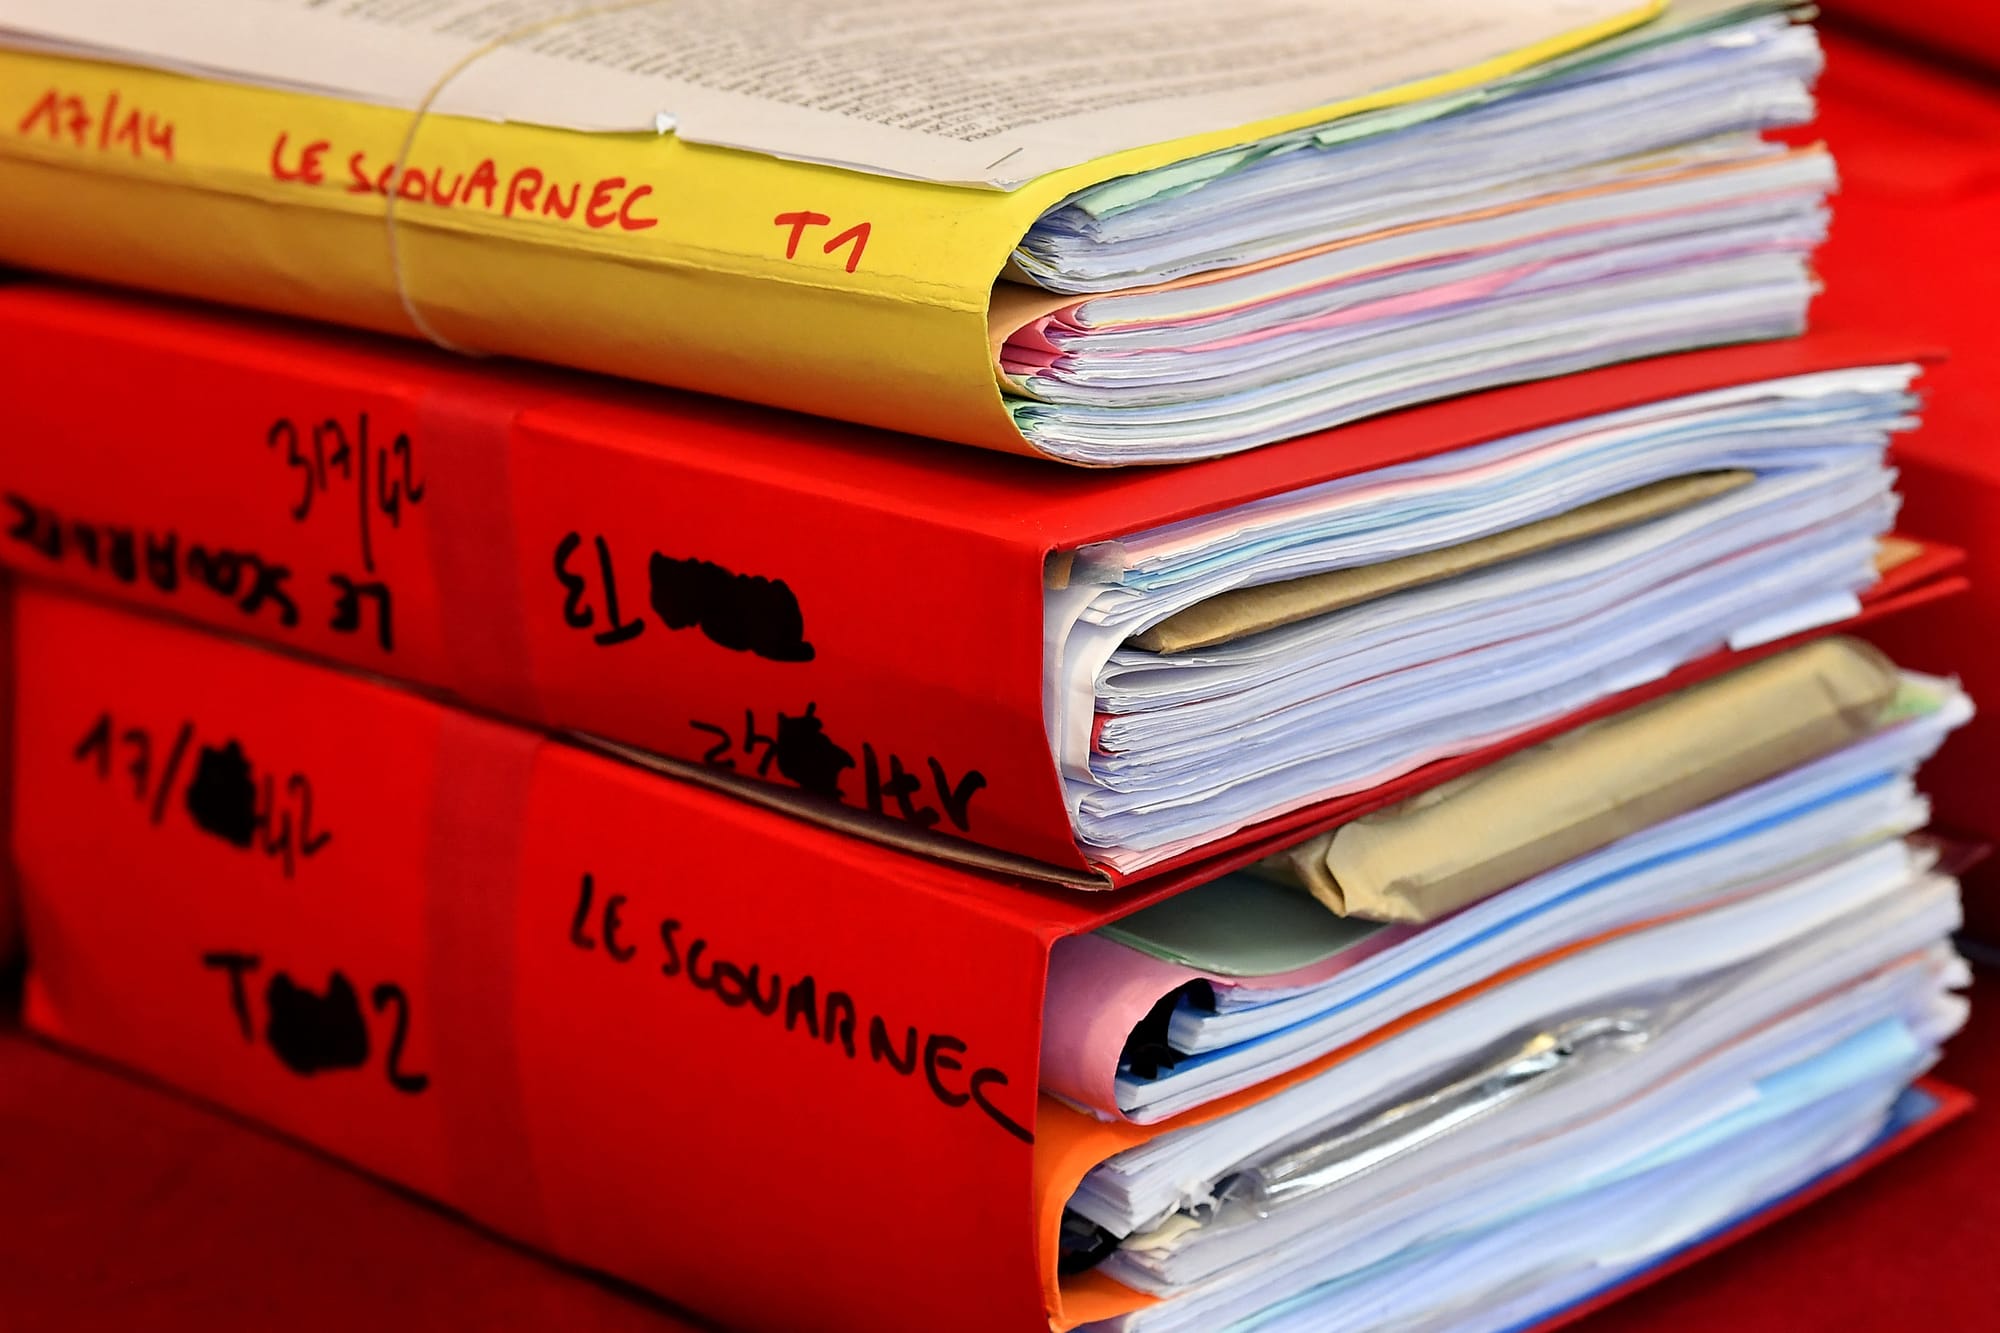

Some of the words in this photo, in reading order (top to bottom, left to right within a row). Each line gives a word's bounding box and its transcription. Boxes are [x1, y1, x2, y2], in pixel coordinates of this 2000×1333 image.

[18, 88, 175, 162] 17/14
[269, 131, 332, 188] LE
[344, 150, 660, 232] SCOUARNEC
[773, 210, 873, 275] T1
[327, 572, 395, 656] LE
[552, 530, 647, 648] T3
[569, 872, 637, 964] LE
[658, 918, 1036, 1146] SCOUARNEC
